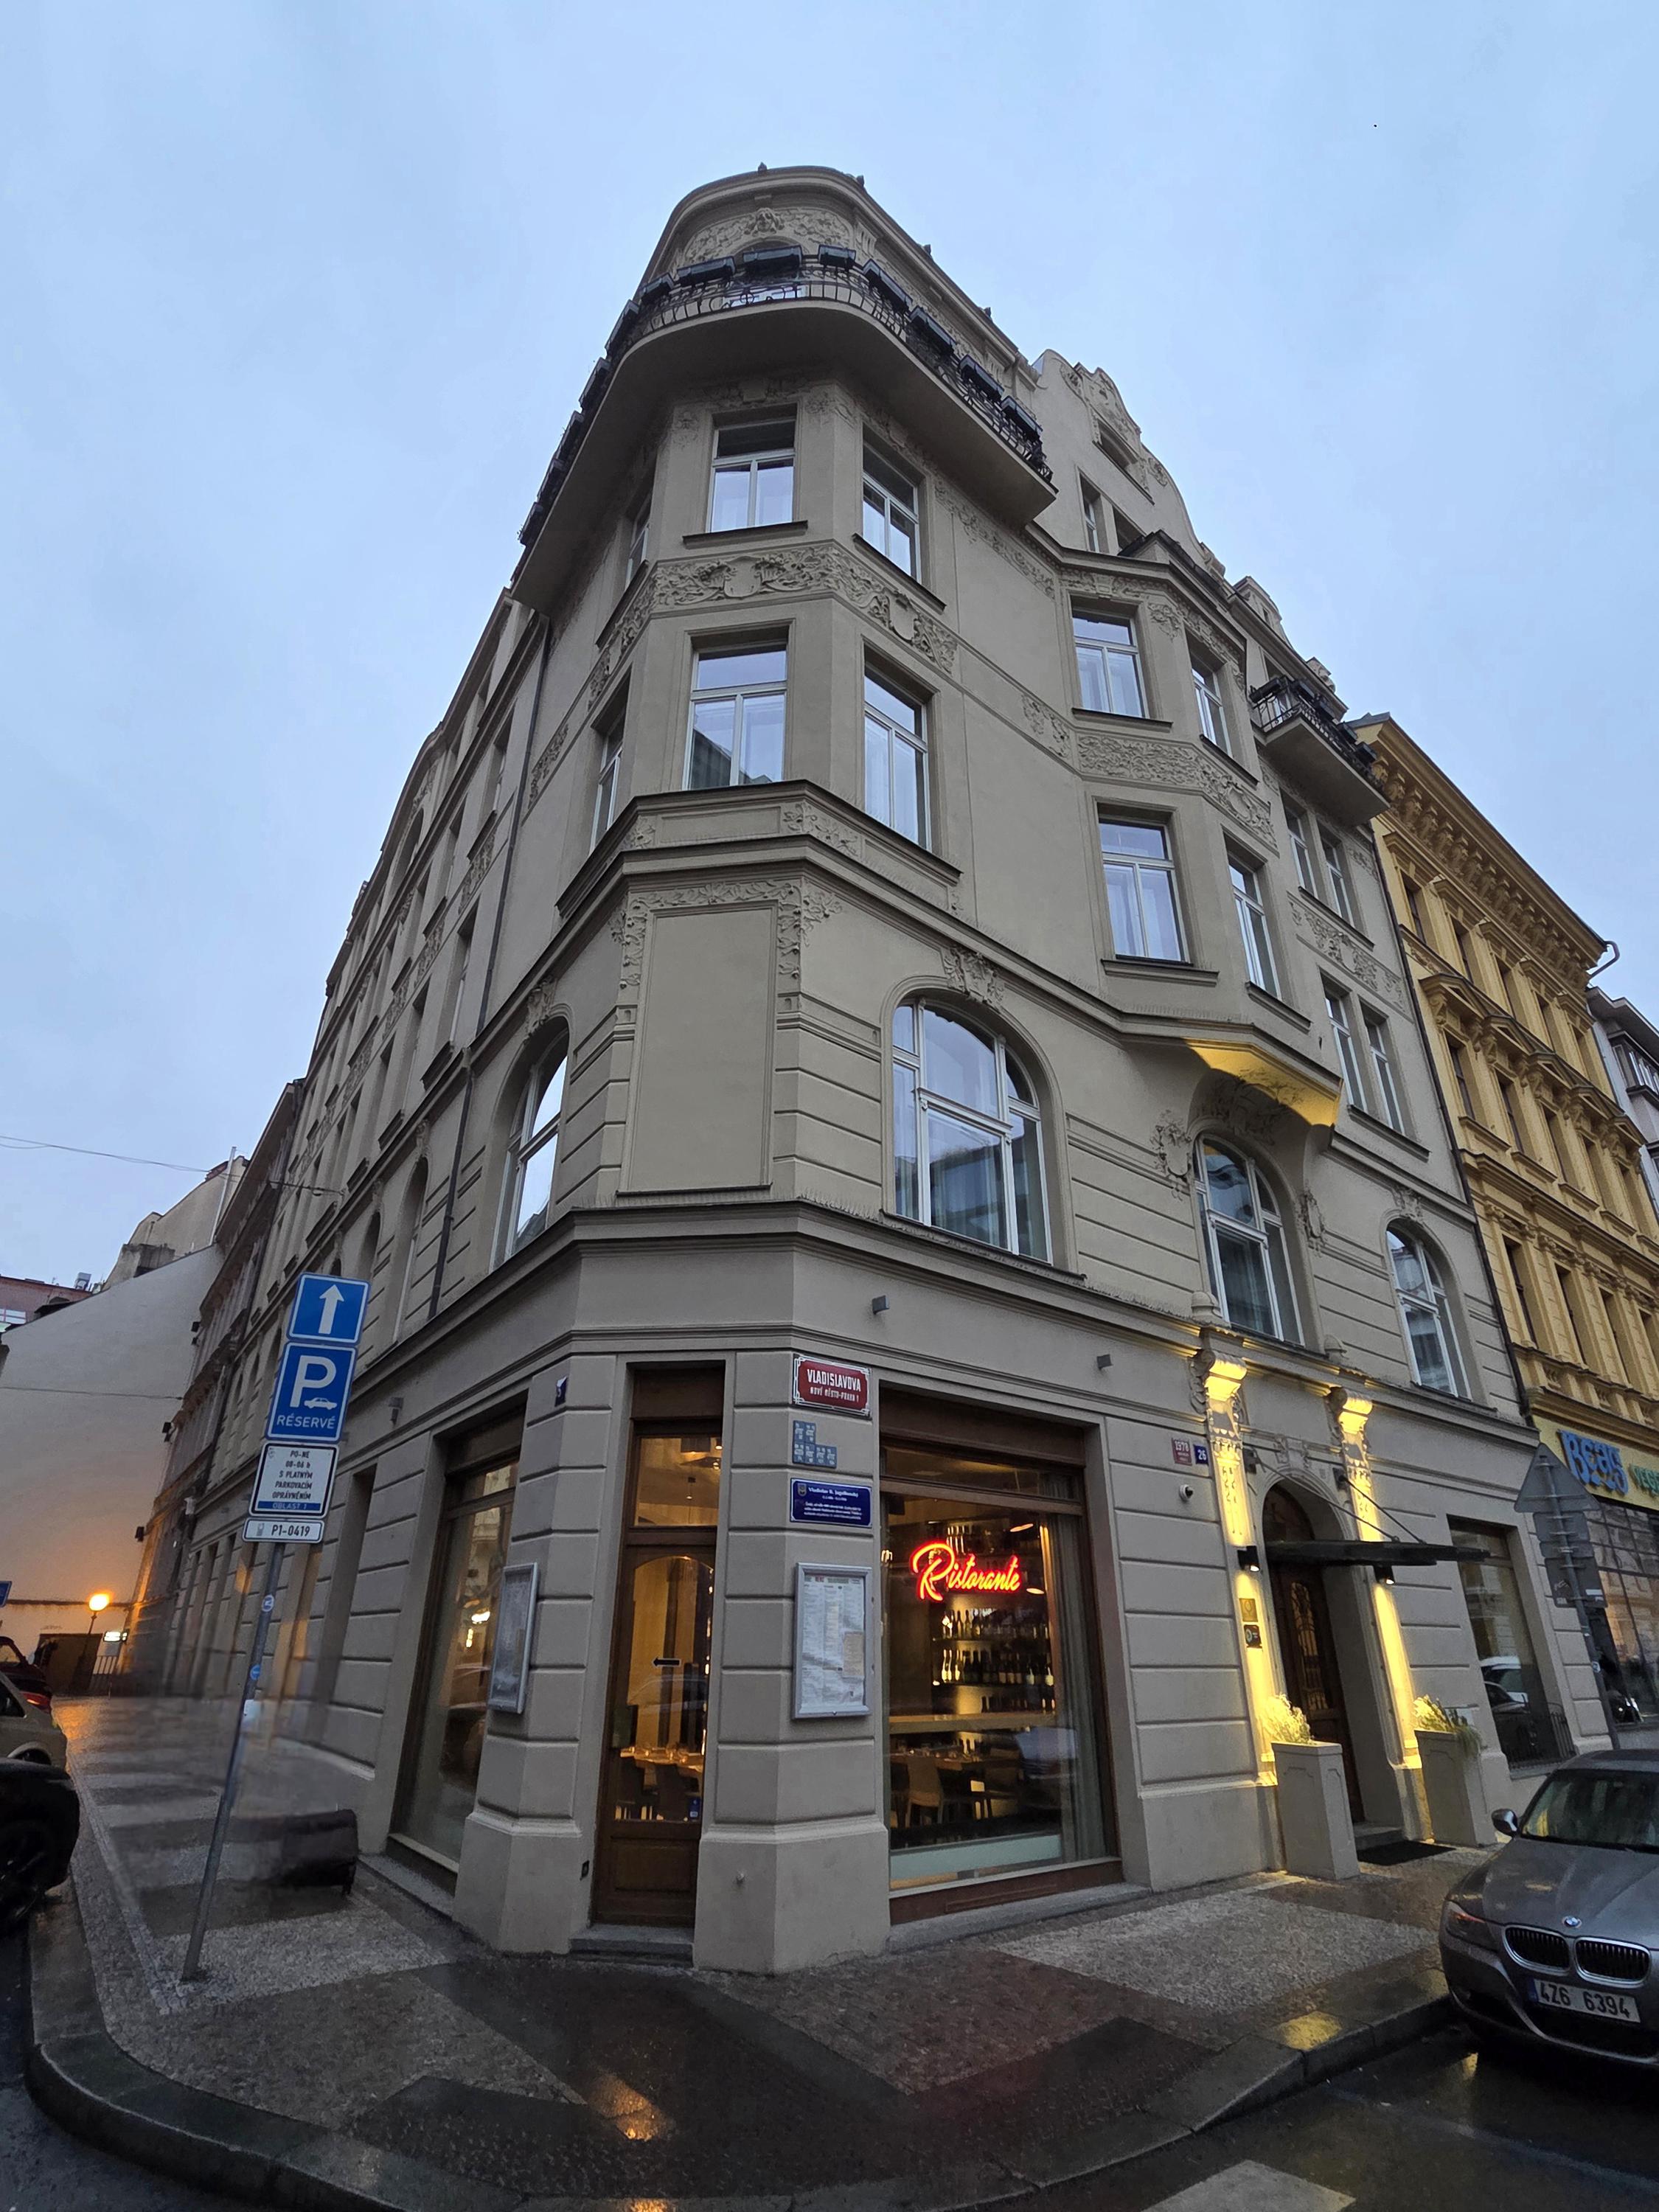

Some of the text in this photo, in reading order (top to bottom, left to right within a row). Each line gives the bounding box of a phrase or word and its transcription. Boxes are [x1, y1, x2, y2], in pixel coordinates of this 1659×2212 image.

[290, 1354, 337, 1408] P
[807, 1368, 861, 1392] VLADISLAVOVA
[276, 1413, 336, 1430] RÉSERVÉ
[290, 1450, 310, 1458] PO-NE
[1197, 1449, 1207, 1461] 26
[285, 1470, 313, 1479] PLATNÝM
[274, 1480, 313, 1489] PARKOVACÍM
[271, 1524, 310, 1537] P1-0419
[911, 1542, 1021, 1601] Ristorante
[1540, 1982, 1630, 2018] 4Z6 6394
